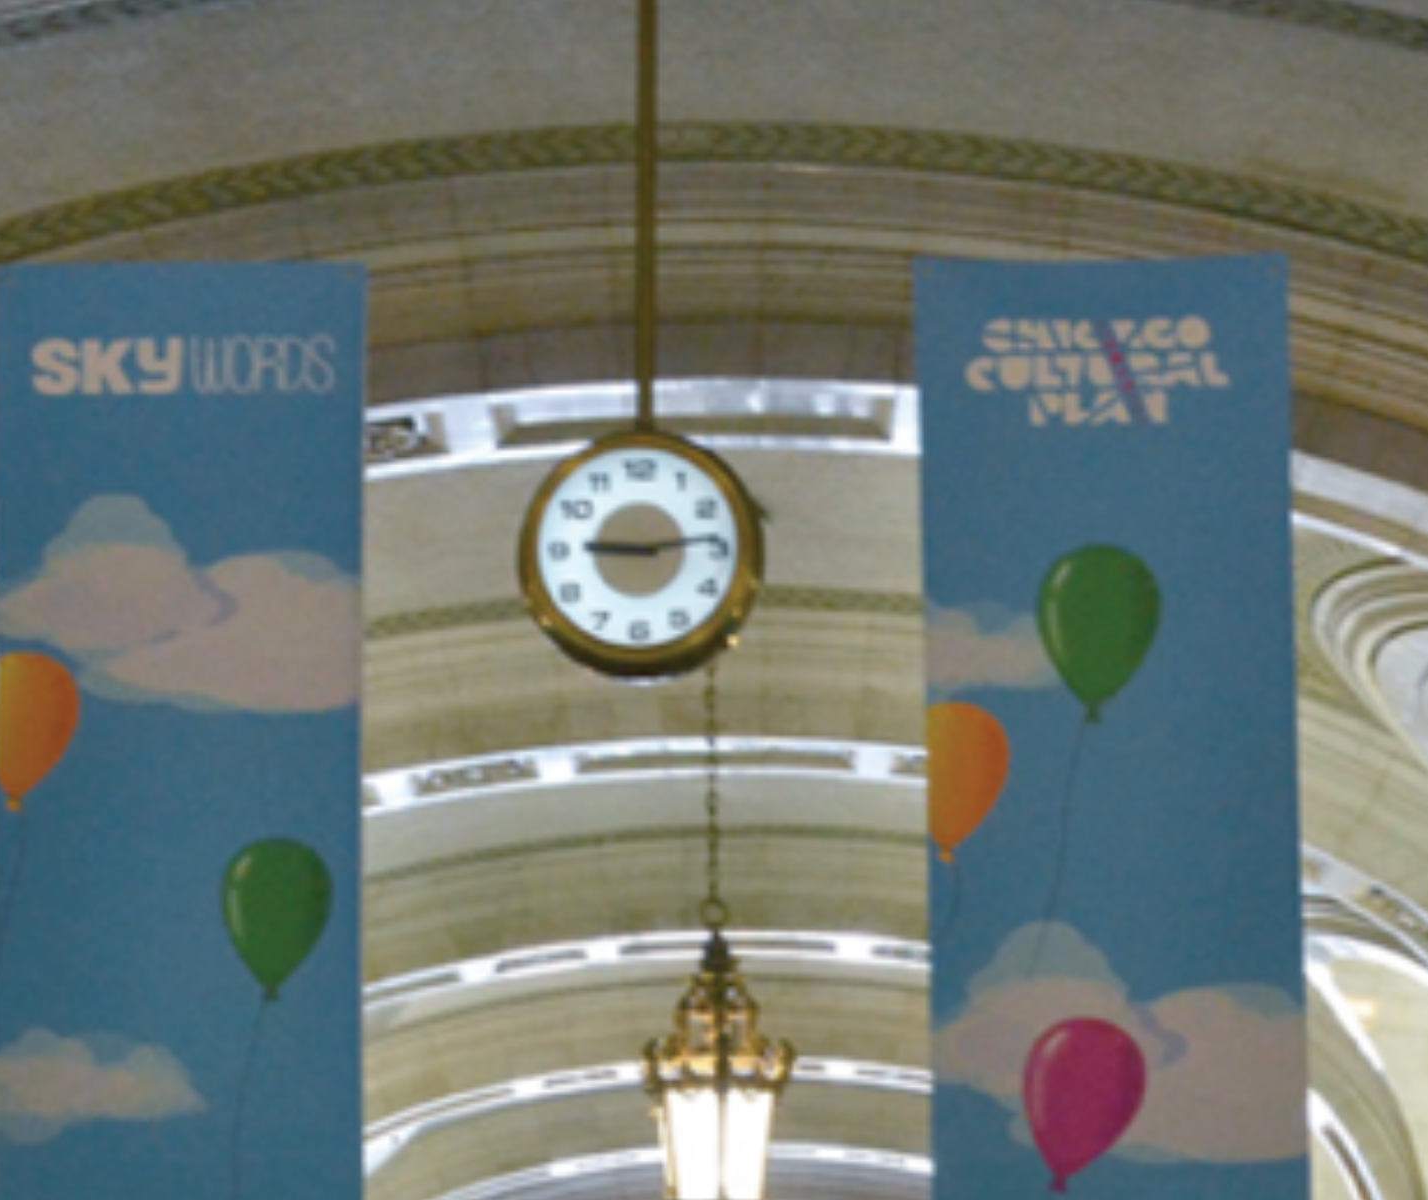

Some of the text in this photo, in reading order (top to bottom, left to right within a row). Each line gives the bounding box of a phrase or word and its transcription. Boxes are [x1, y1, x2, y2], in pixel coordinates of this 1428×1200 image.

[30, 336, 184, 395] SKY
[965, 352, 1230, 392] CULTURAL
[623, 458, 658, 482] 12
[587, 472, 611, 492] 11
[674, 471, 688, 492] 1
[559, 499, 594, 520] 10
[694, 499, 718, 520] 2
[547, 541, 571, 562] 9
[559, 582, 581, 604] 8
[696, 577, 719, 597] 4
[589, 610, 610, 631] 7
[667, 609, 692, 630] 5
[628, 620, 651, 642] 6
